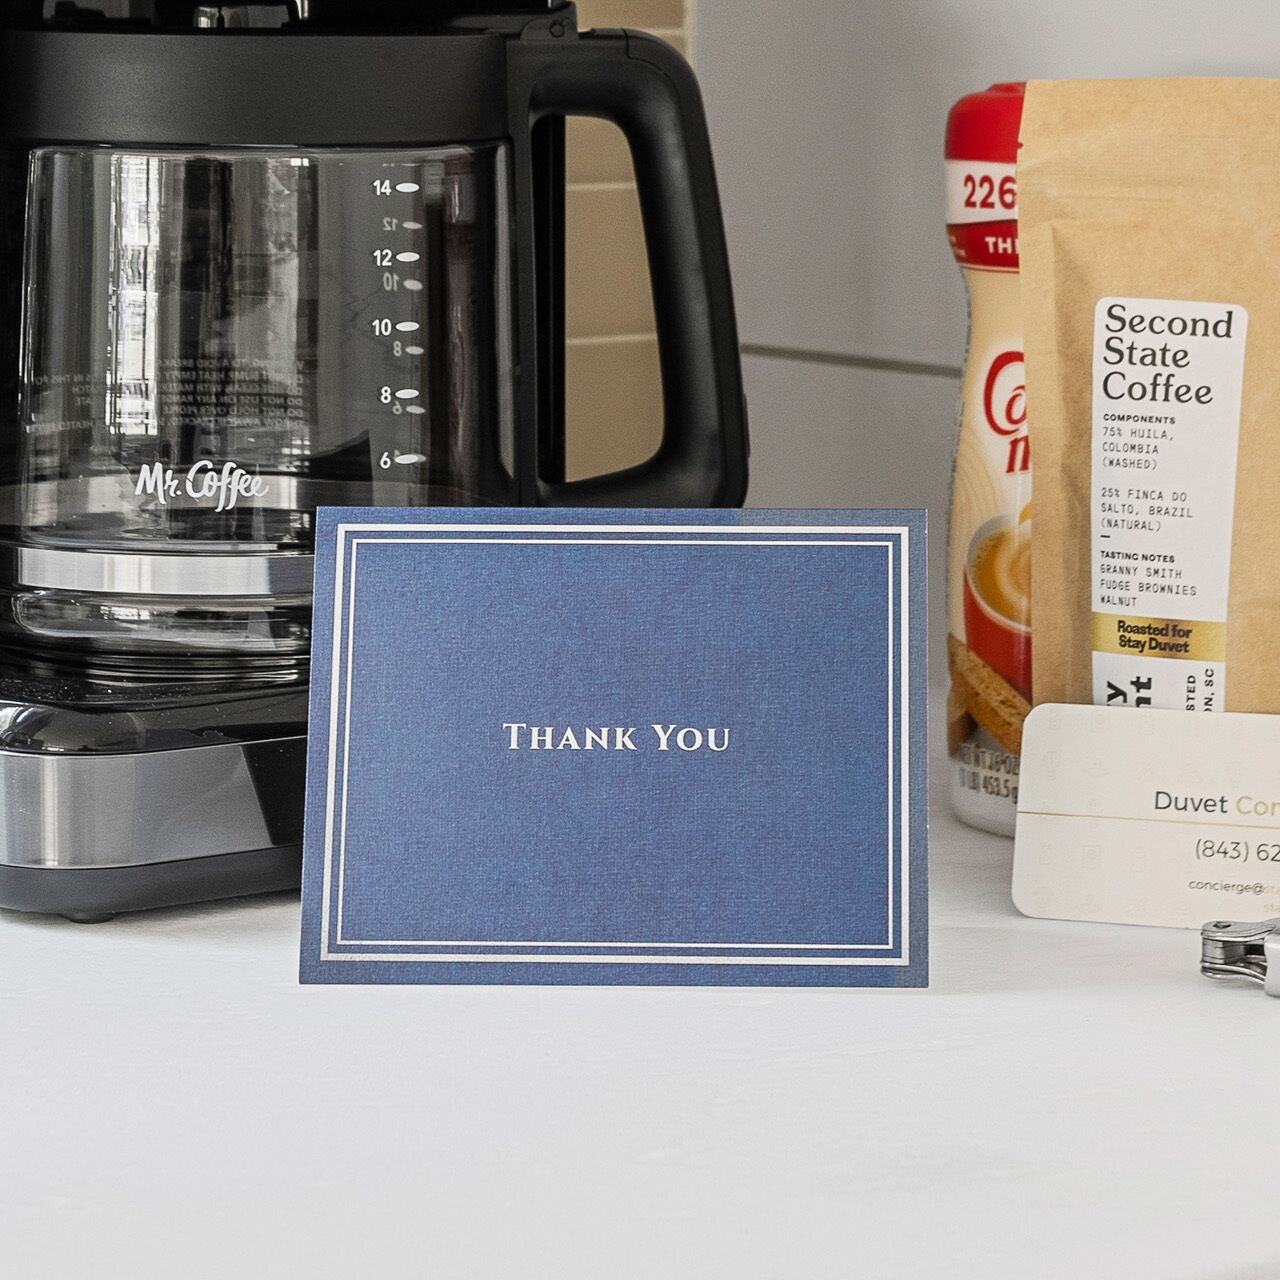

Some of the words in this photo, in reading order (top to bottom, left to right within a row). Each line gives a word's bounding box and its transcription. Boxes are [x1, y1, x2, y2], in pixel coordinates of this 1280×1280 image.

[372, 180, 392, 196] 14
[963, 174, 1017, 210] 226
[373, 249, 393, 267] 12
[372, 319, 392, 337] 10
[1105, 304, 1233, 338] Second
[1103, 336, 1191, 368] State
[380, 386, 391, 404] 8
[1102, 371, 1213, 404] Coffee
[1103, 413, 1176, 424] COMPONENTS
[1103, 426, 1123, 437] 75%
[1130, 428, 1174, 441] HUILA,
[1102, 442, 1159, 454] COLOMBIA
[379, 452, 391, 469] 6
[1102, 458, 1158, 470] (WASHED)
[135, 463, 182, 505] Mr.
[185, 460, 269, 512] Coffee
[1101, 487, 1121, 499] 25%
[1127, 489, 1164, 501] FINCA
[1172, 491, 1188, 502] DO
[1101, 502, 1140, 516] SALTO,
[1148, 505, 1194, 519] BRAZIL
[1101, 518, 1162, 532] (NATURAL)
[1100, 550, 1139, 561] TASTING
[1141, 553, 1175, 564] NOTES
[1100, 564, 1138, 577] GRANNY
[1146, 567, 1182, 580] SMITH
[1100, 579, 1131, 592] FUDGE
[1138, 581, 1197, 596] BROWNIES
[1100, 596, 1137, 607] WALNUT
[1117, 620, 1169, 638] Roasted
[1171, 623, 1192, 638] for
[1118, 635, 1146, 653] Stay
[1148, 637, 1190, 653] Duvet
[503, 723, 638, 752] THANK
[651, 724, 731, 752] YOU
[1154, 790, 1228, 815] Duvet
[1195, 838, 1249, 862] (843)
